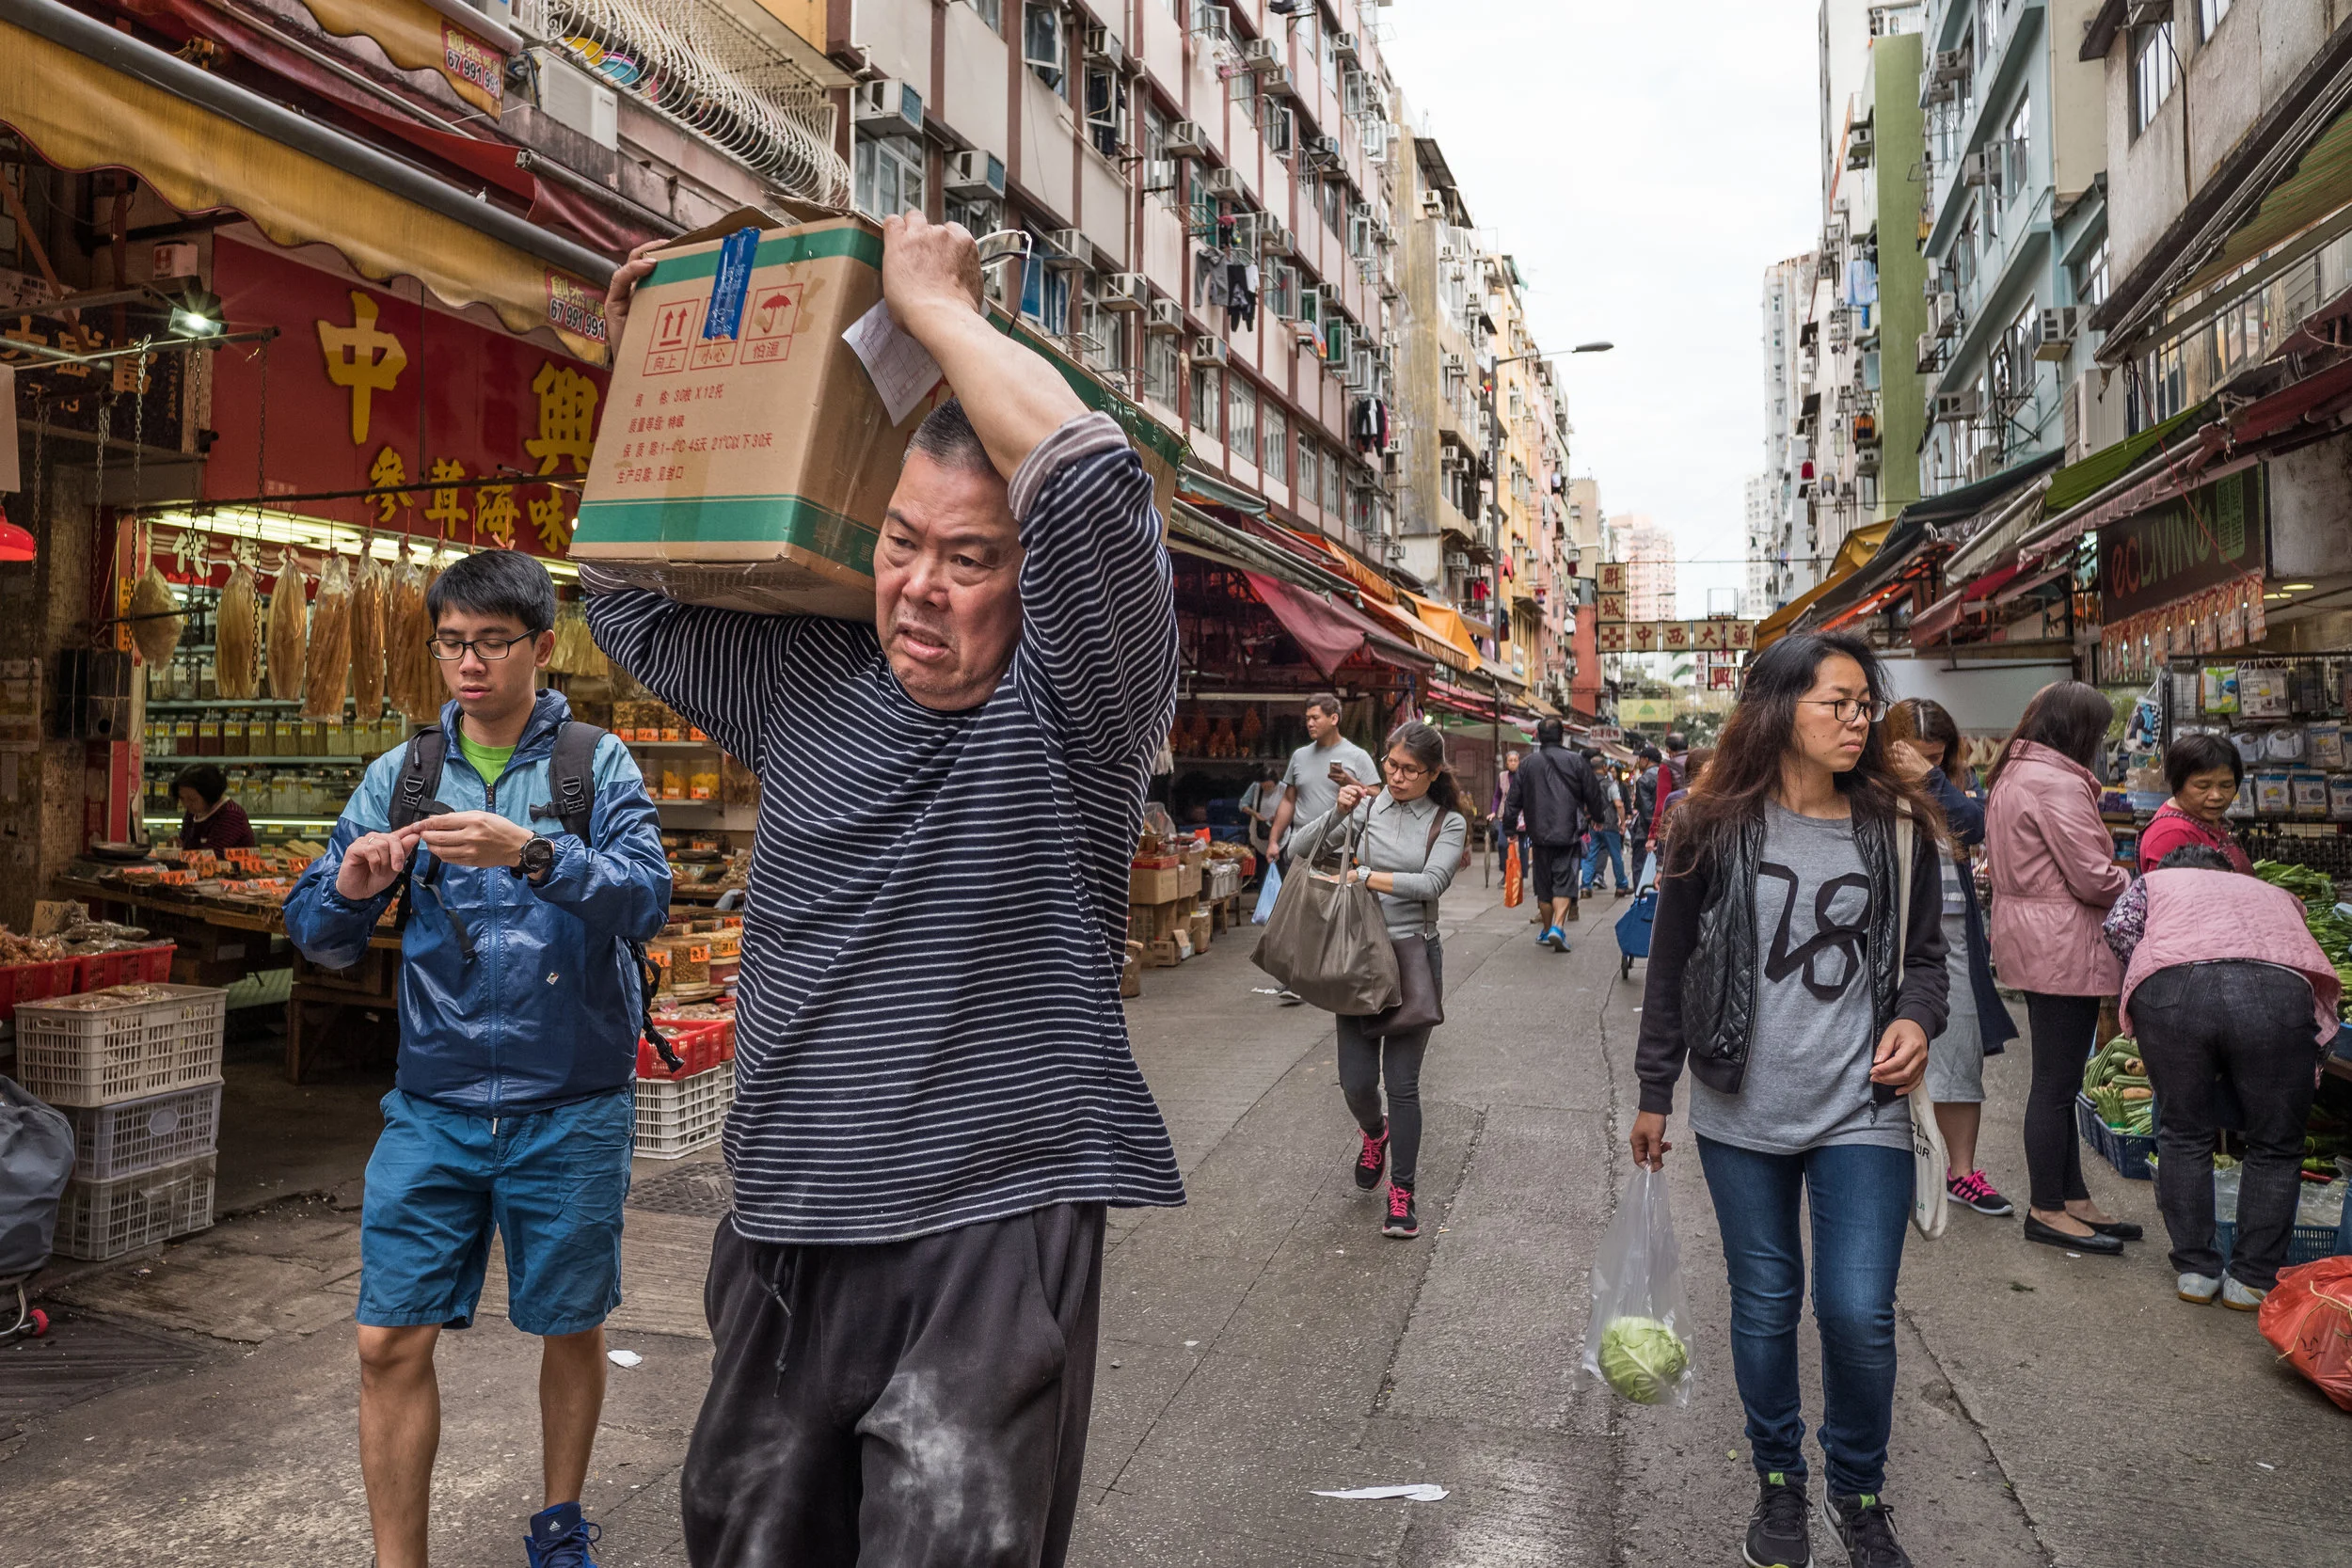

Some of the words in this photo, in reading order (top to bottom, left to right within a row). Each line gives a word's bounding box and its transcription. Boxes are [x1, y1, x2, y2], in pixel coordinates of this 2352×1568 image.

[447, 49, 461, 72] 67
[463, 57, 483, 85] 991
[484, 70, 500, 99] 991
[550, 297, 565, 323] 67
[565, 305, 584, 332] 991
[585, 313, 605, 341] 991
[652, 353, 676, 372] 向上
[700, 346, 725, 365] 小心
[1602, 566, 1624, 619] 聯城
